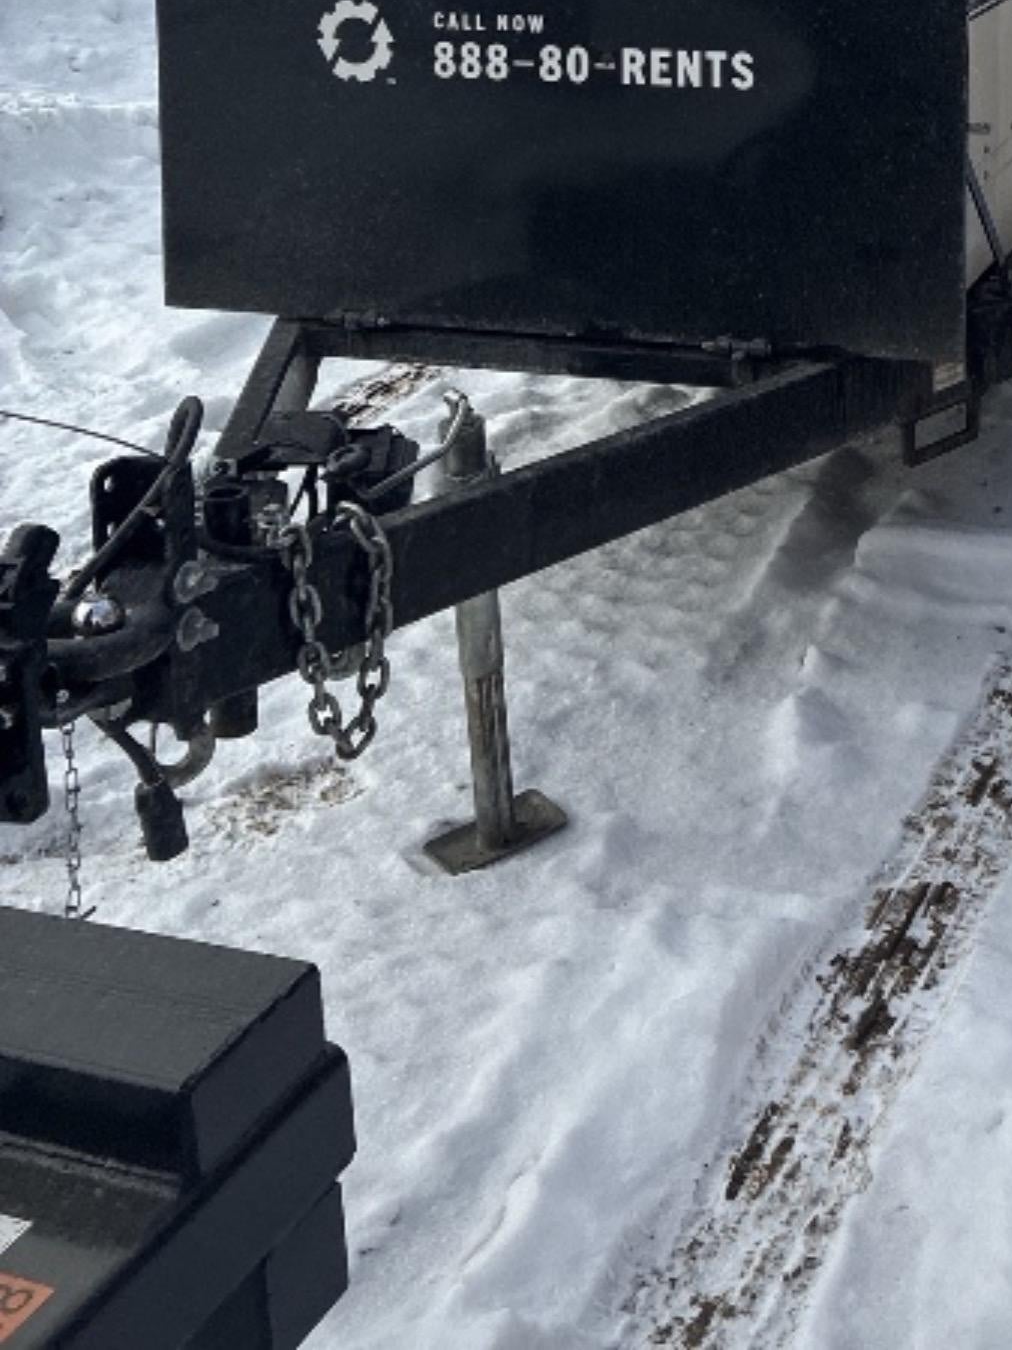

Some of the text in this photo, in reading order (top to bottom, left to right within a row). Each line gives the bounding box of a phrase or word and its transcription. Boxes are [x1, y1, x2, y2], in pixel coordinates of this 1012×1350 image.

[433, 11, 544, 34] CALL NOW
[433, 41, 754, 91] 888-80-RENTS
